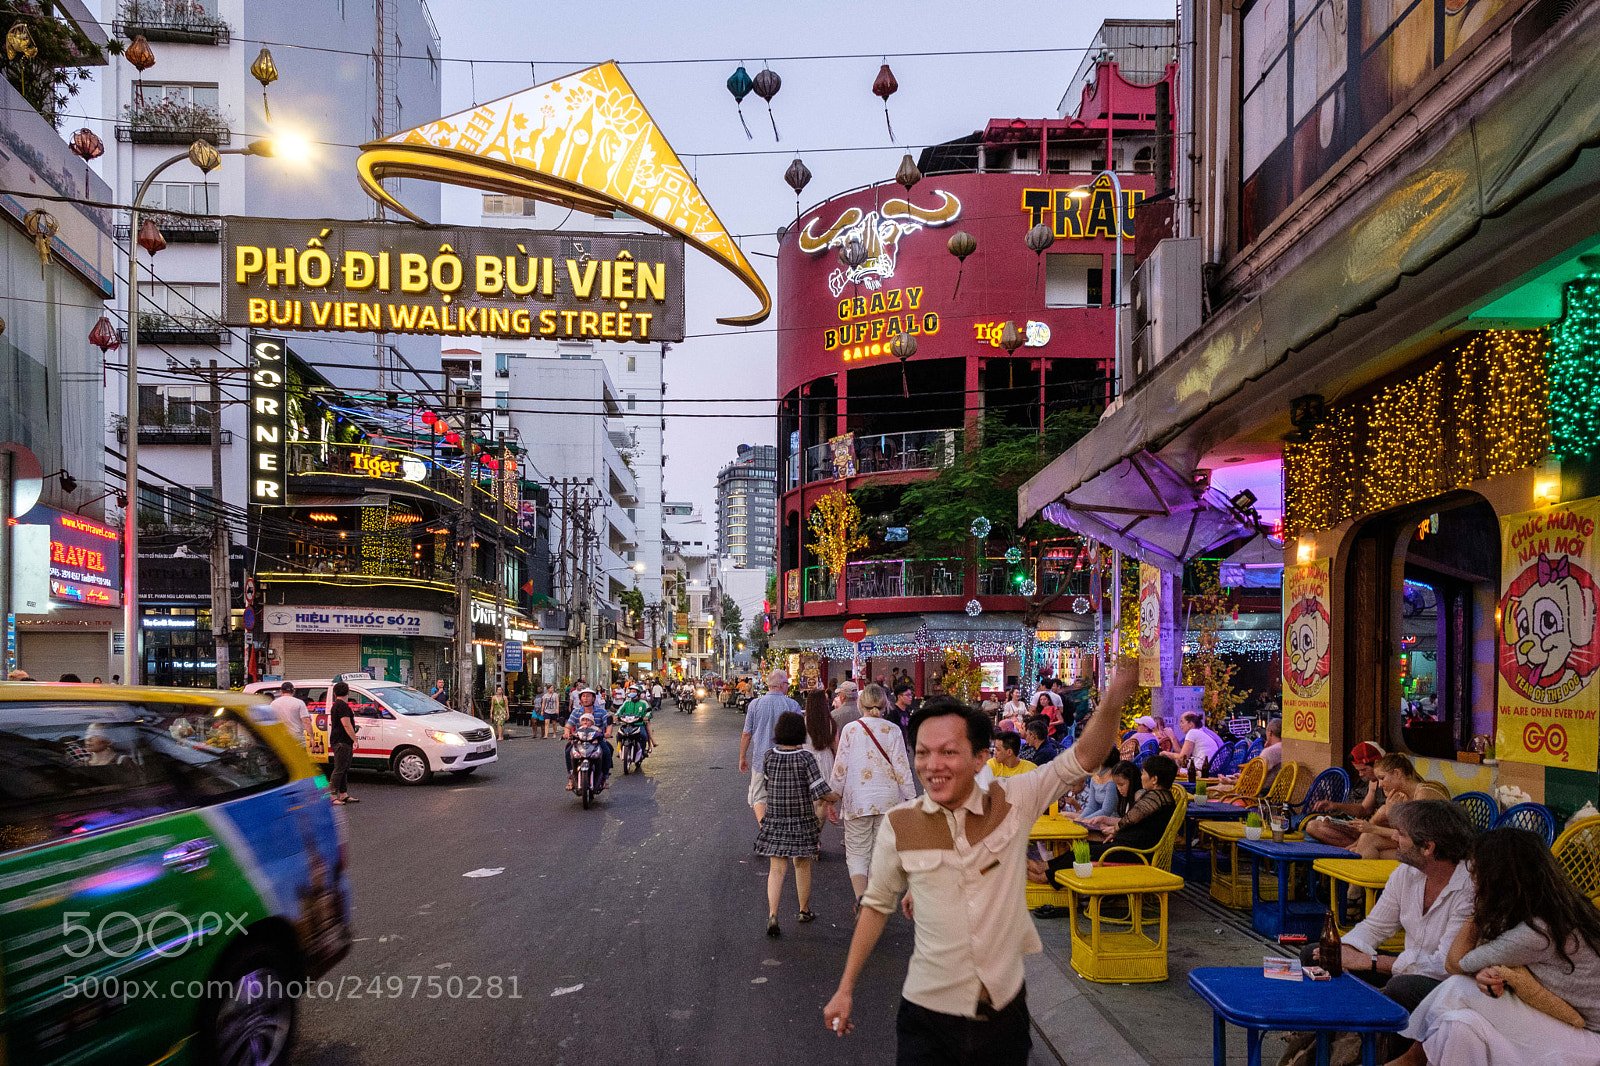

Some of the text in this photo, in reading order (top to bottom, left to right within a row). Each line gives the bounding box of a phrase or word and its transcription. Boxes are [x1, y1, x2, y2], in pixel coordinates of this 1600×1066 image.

[236, 228, 666, 310] PHỐ ĐI BỘ BÙI VIỆN
[249, 297, 653, 337] BUI VIEN WALKING STREET
[838, 286, 923, 321] CRAZY
[824, 312, 939, 351] BUFFALO
[254, 342, 282, 498] CORNER
[350, 452, 400, 479] Tiger
[1511, 515, 1543, 549] CHÚC
[407, 616, 421, 627] 22
[1515, 673, 1580, 702] YEAR OF THE DOG
[1500, 705, 1597, 720] WE ARE OPEN EVERYDAY
